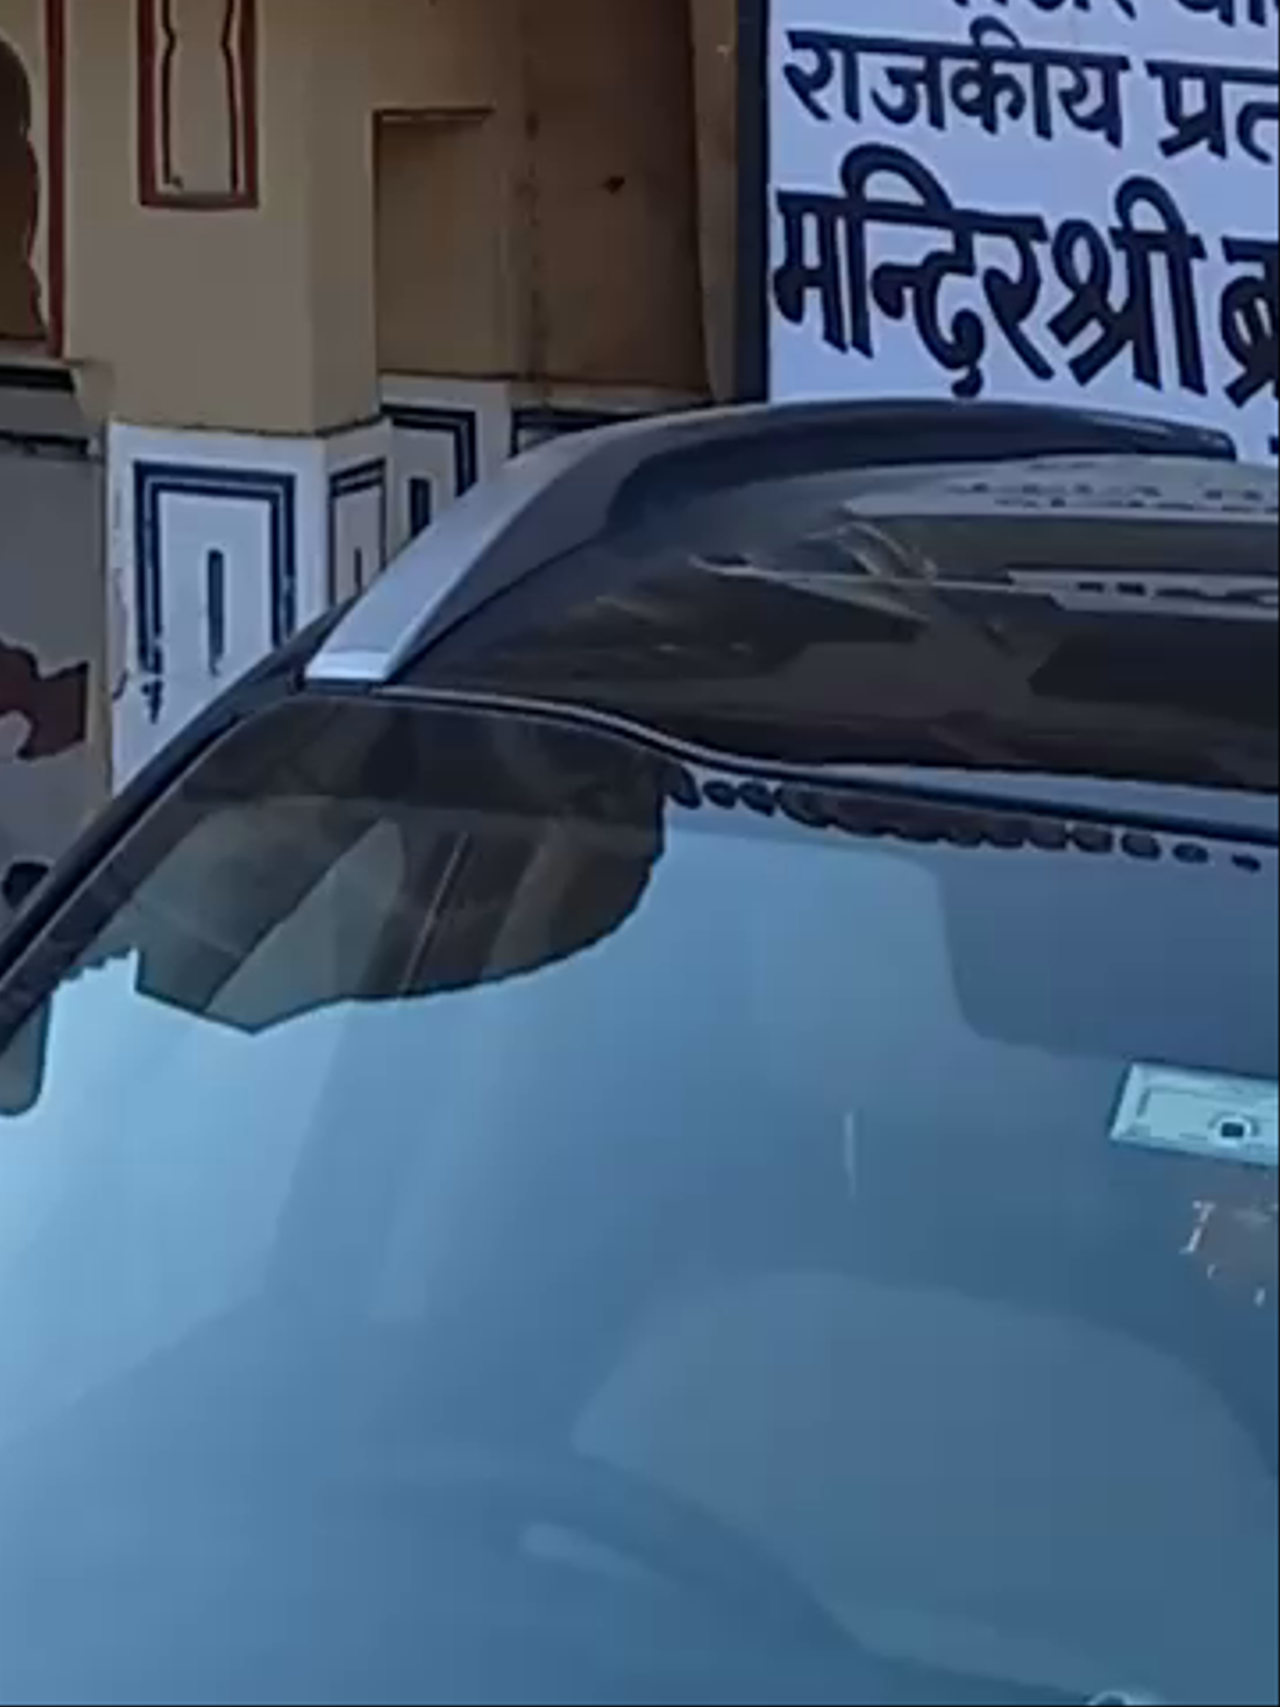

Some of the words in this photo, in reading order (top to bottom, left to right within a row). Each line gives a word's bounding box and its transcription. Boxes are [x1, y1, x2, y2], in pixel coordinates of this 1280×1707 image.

[782, 15, 1130, 148] राजकीय
[772, 142, 1054, 399] मन्दिर
[1046, 174, 1208, 397] श्री
